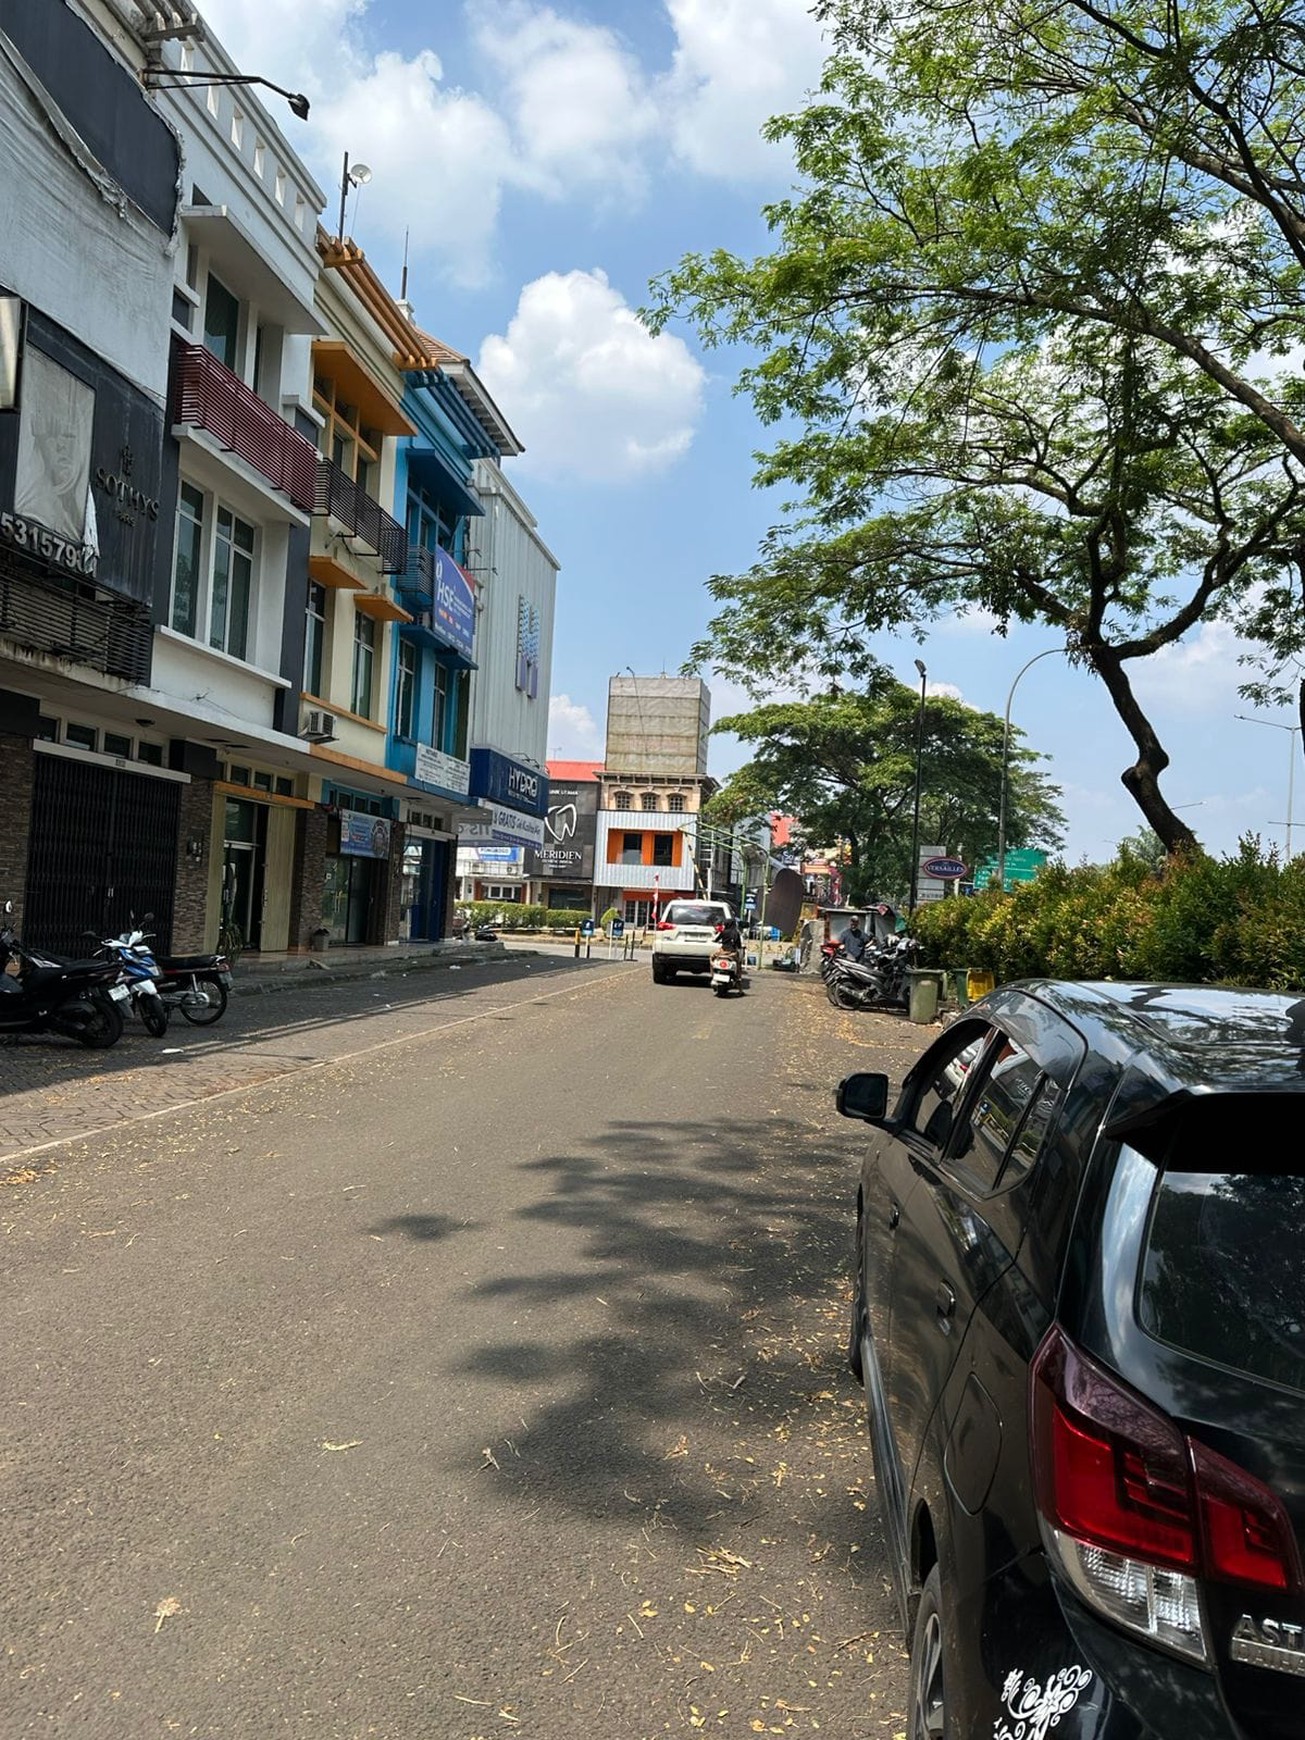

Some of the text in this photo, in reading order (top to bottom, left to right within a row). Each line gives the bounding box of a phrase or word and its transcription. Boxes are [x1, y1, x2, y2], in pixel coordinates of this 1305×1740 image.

[96, 467, 159, 521] SOTHYS
[508, 765, 538, 798] HYDRO
[534, 849, 582, 860] MERIDIEN
